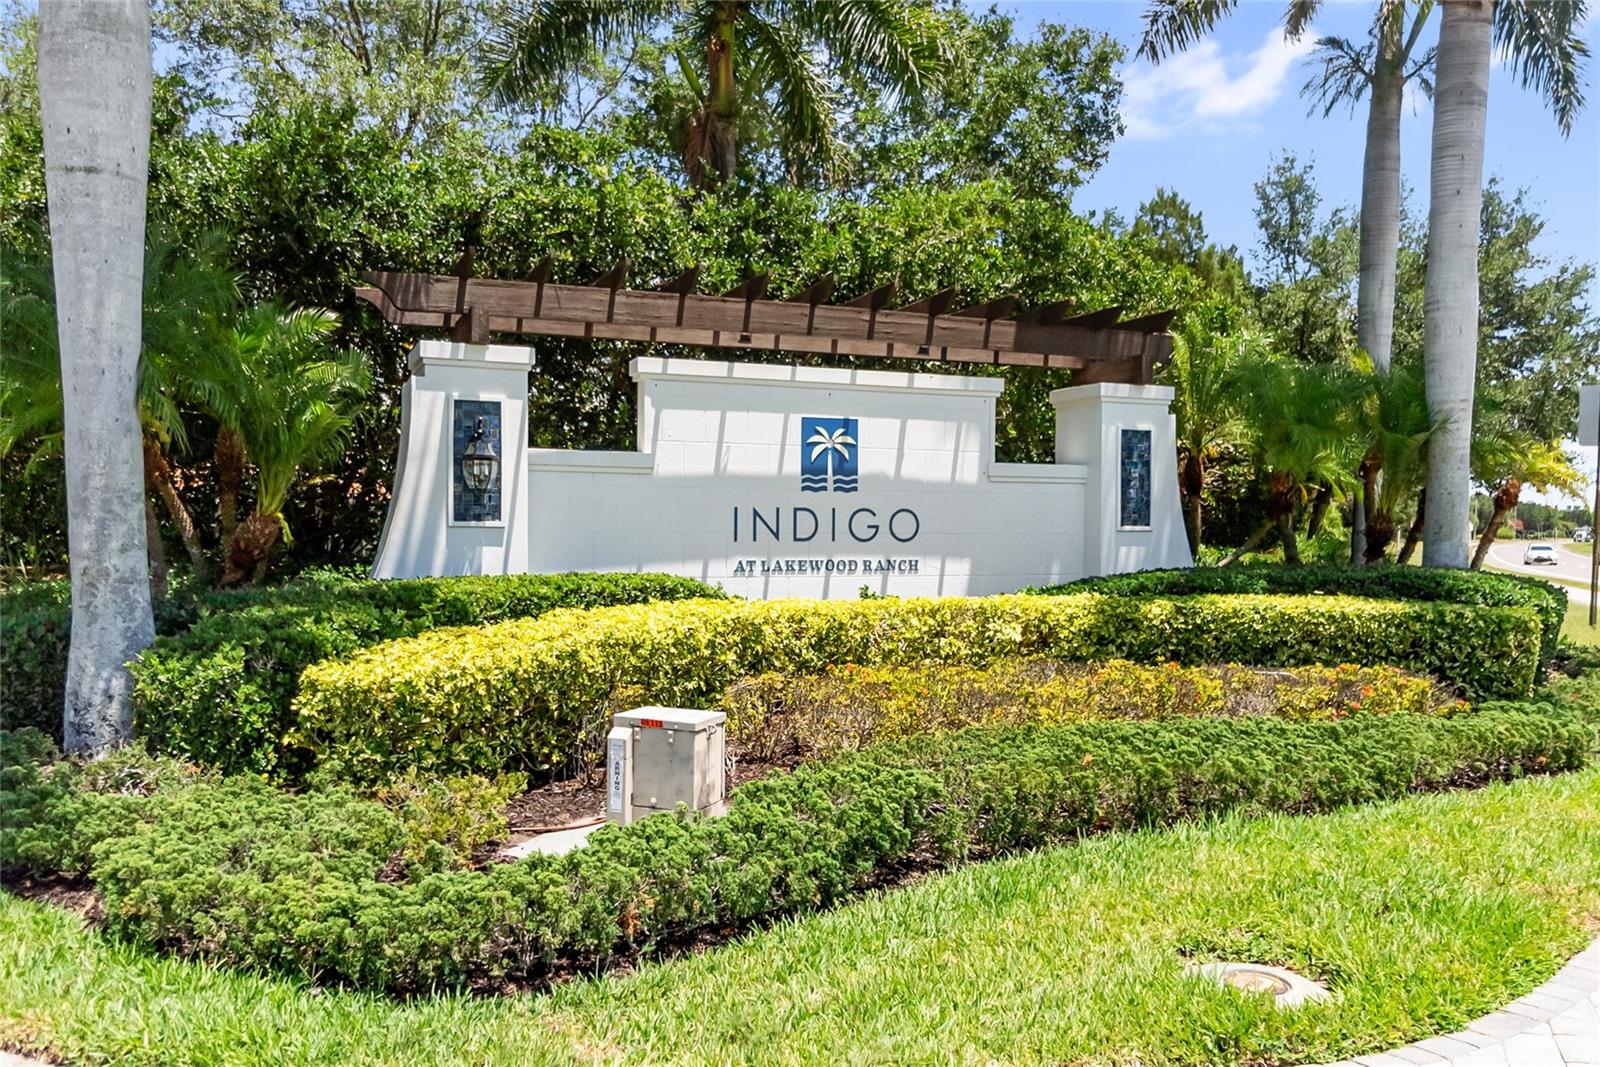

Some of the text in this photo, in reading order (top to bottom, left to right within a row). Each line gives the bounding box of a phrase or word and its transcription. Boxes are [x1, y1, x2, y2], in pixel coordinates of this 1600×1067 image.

[733, 506, 920, 543] INDIGO
[733, 559, 920, 573] AT LAKEWOOD RANCH
